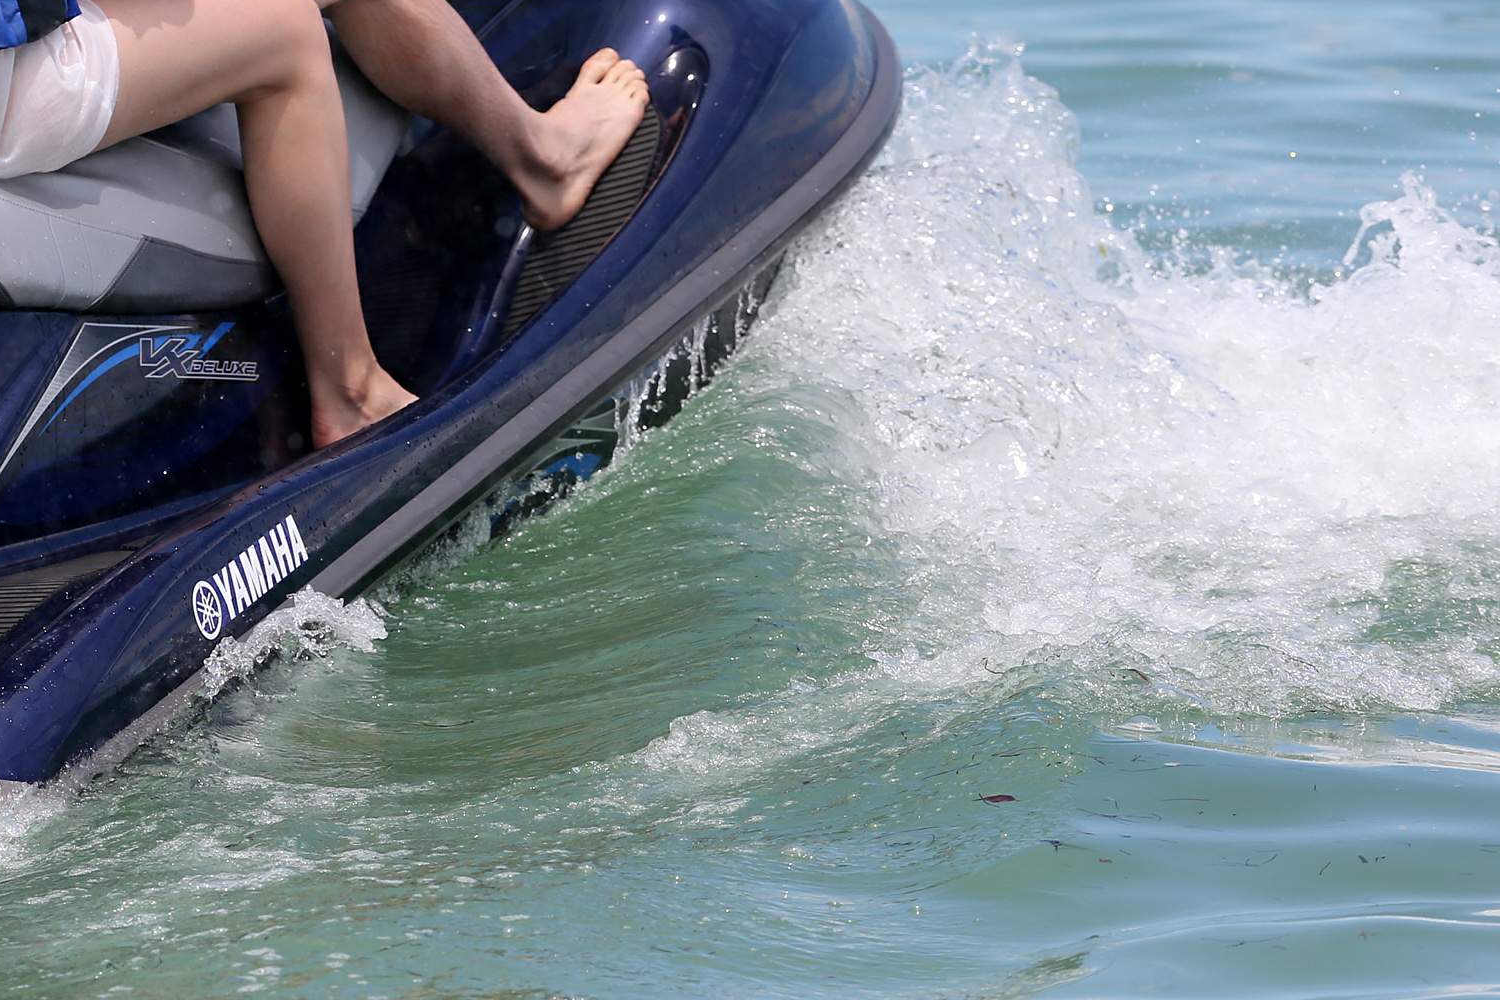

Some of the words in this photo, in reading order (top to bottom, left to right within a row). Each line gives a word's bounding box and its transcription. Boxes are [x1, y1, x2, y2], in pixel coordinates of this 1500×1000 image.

[140, 338, 200, 378] VX
[190, 360, 257, 376] DELUXE
[212, 514, 309, 620] YAMAHA
